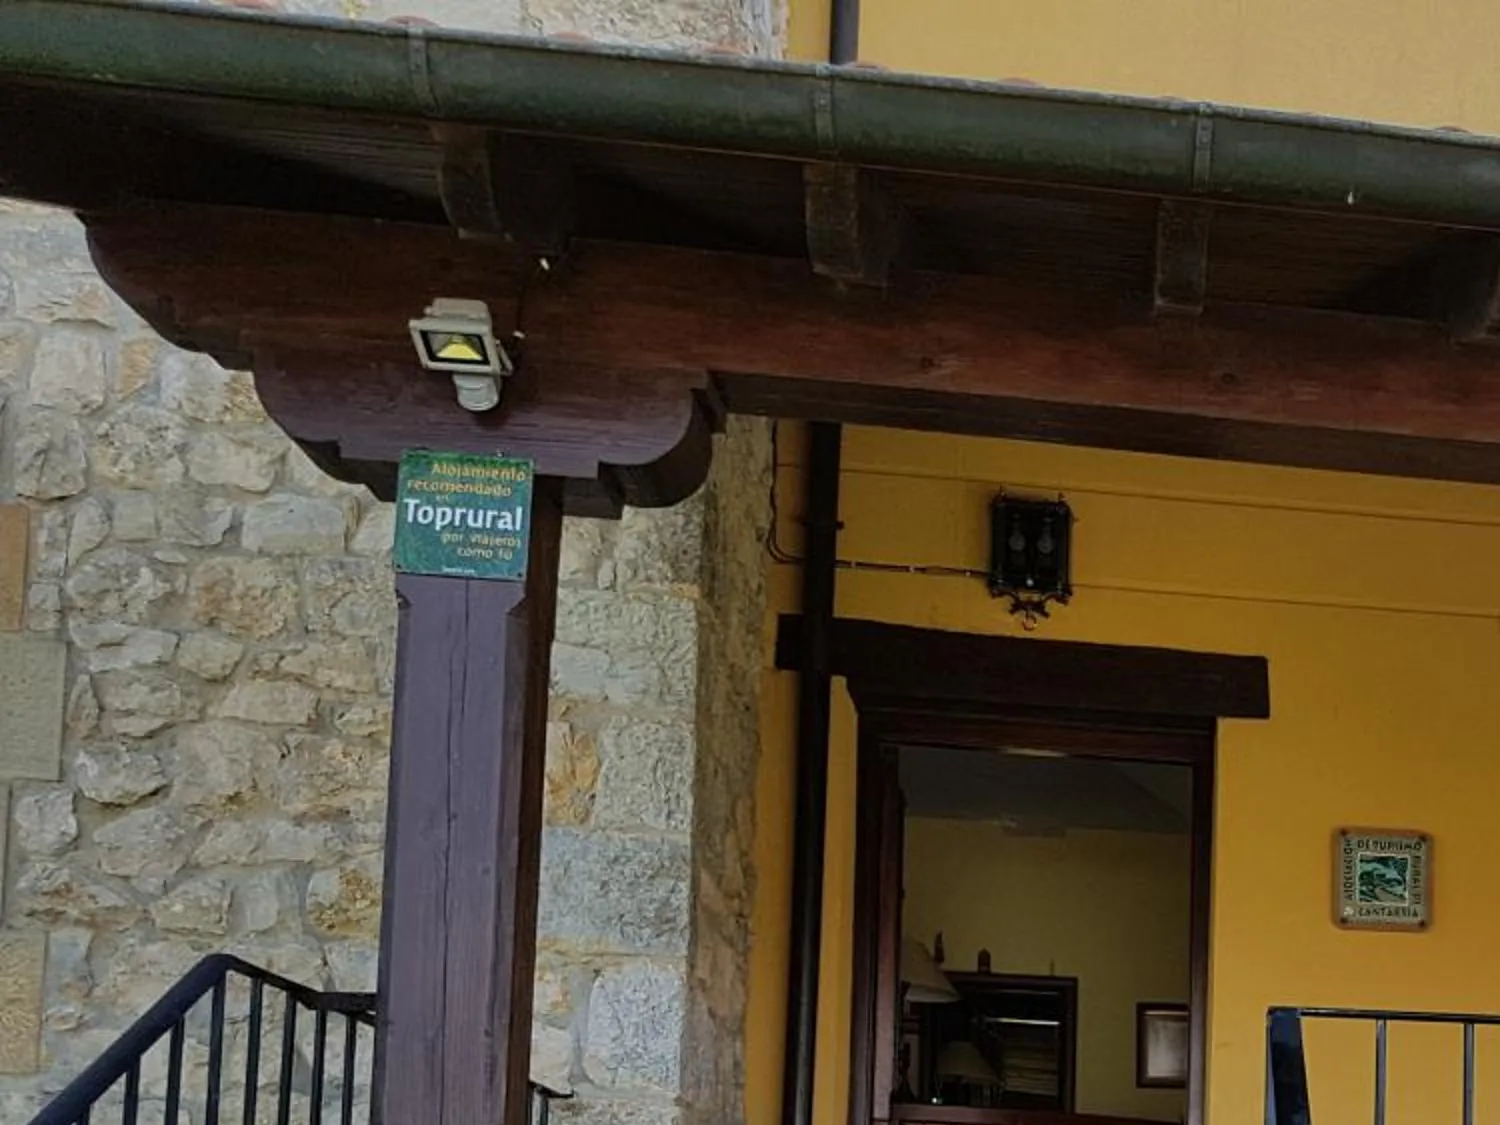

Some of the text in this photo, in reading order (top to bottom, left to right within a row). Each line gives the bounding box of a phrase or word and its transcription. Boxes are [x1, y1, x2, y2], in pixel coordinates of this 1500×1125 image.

[431, 461, 527, 482] Alojamiento
[406, 478, 513, 498] recomendado
[402, 497, 524, 532] Toprural
[456, 546, 494, 560] como
